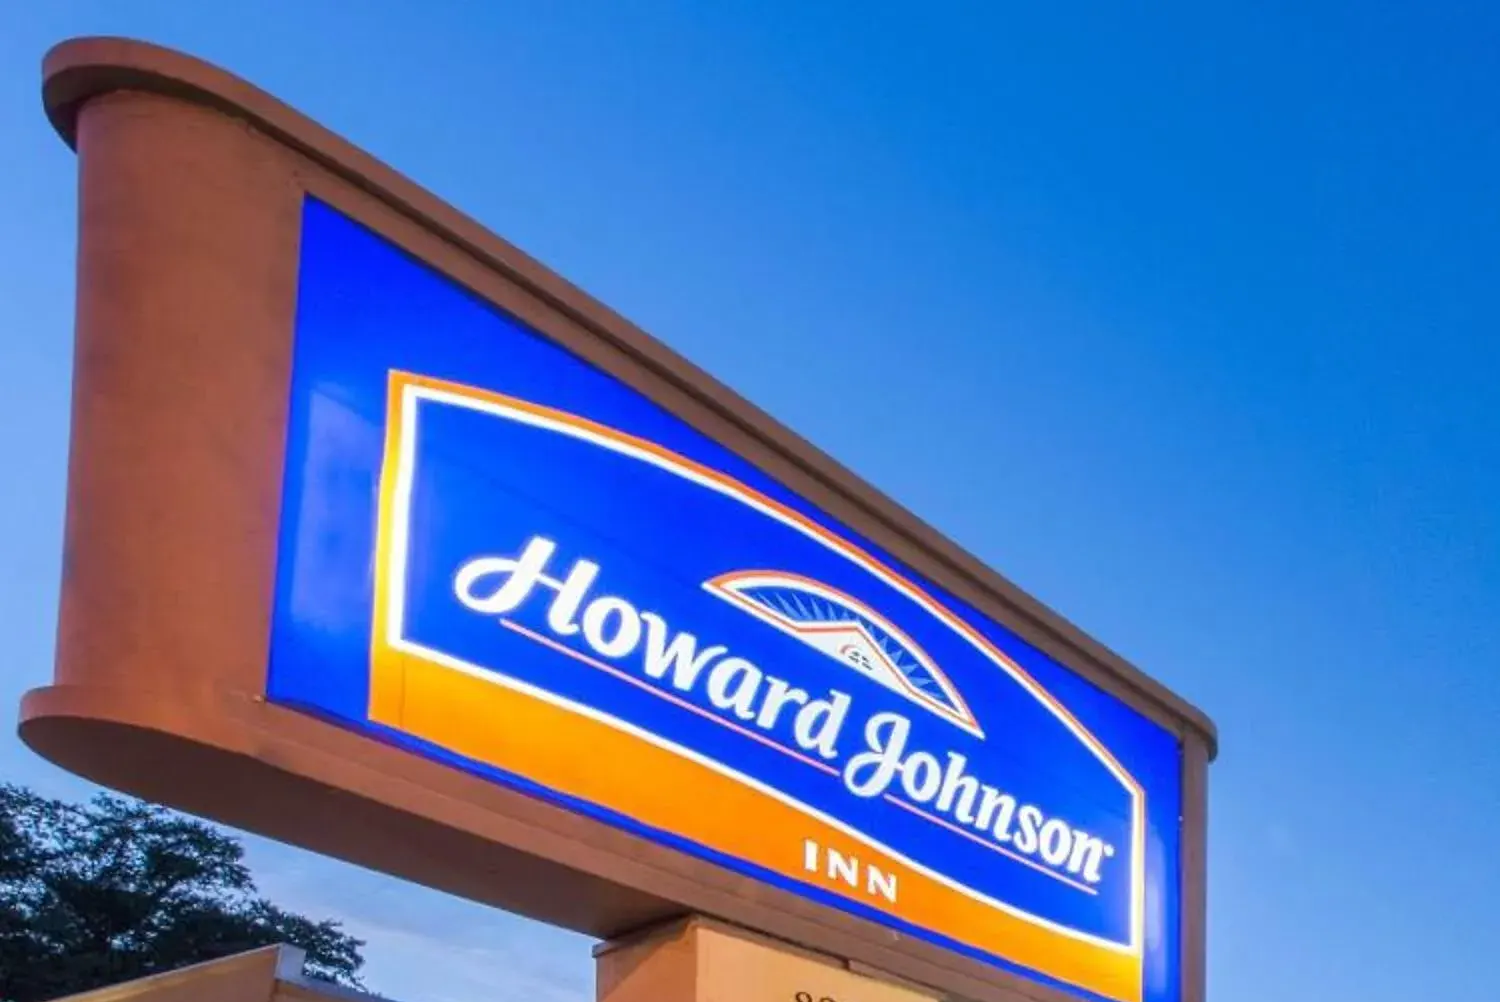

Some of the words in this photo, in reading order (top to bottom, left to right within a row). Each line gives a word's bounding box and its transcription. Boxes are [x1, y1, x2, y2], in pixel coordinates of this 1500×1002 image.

[454, 536, 851, 759] Howard
[844, 711, 1103, 883] Johnson
[804, 838, 897, 904] INN
